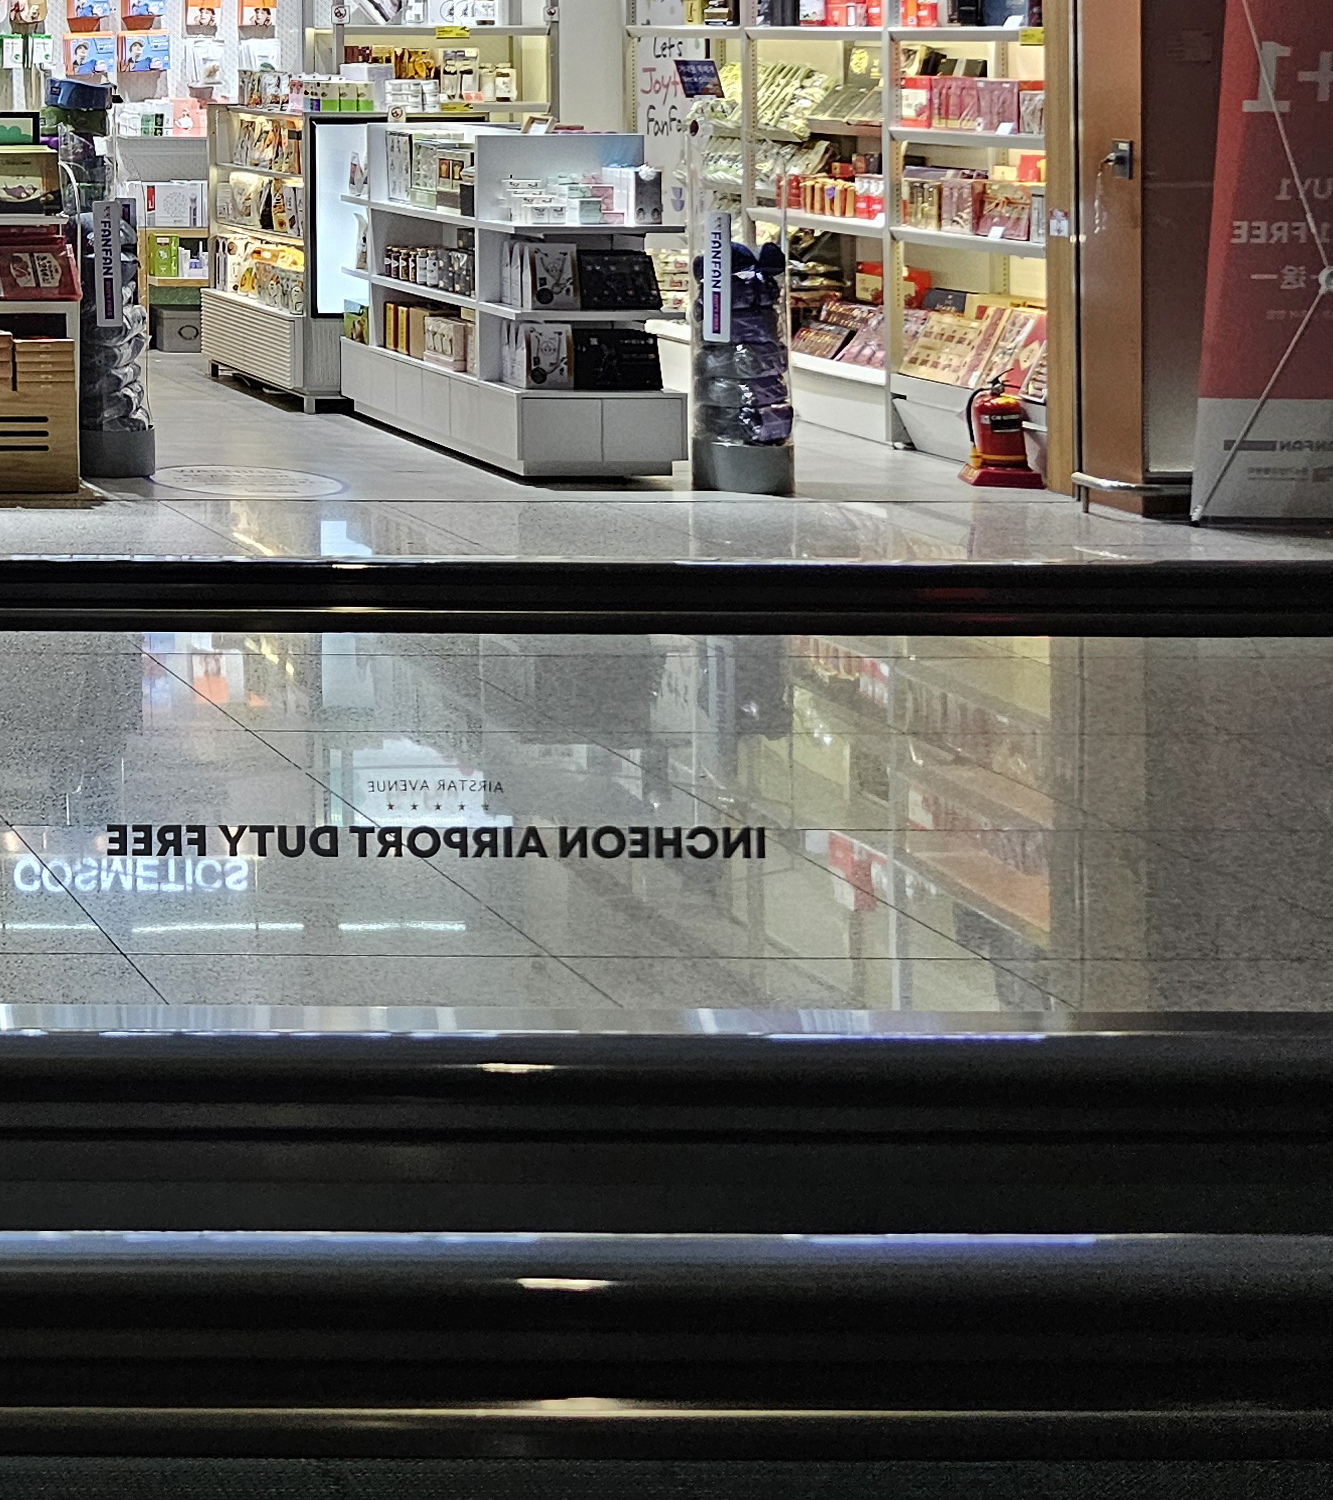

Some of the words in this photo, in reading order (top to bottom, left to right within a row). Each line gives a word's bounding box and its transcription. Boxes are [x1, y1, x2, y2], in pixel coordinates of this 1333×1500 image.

[646, 105, 688, 136] FanFa
[100, 220, 113, 276] FANFAN
[711, 232, 722, 289] FANFAN
